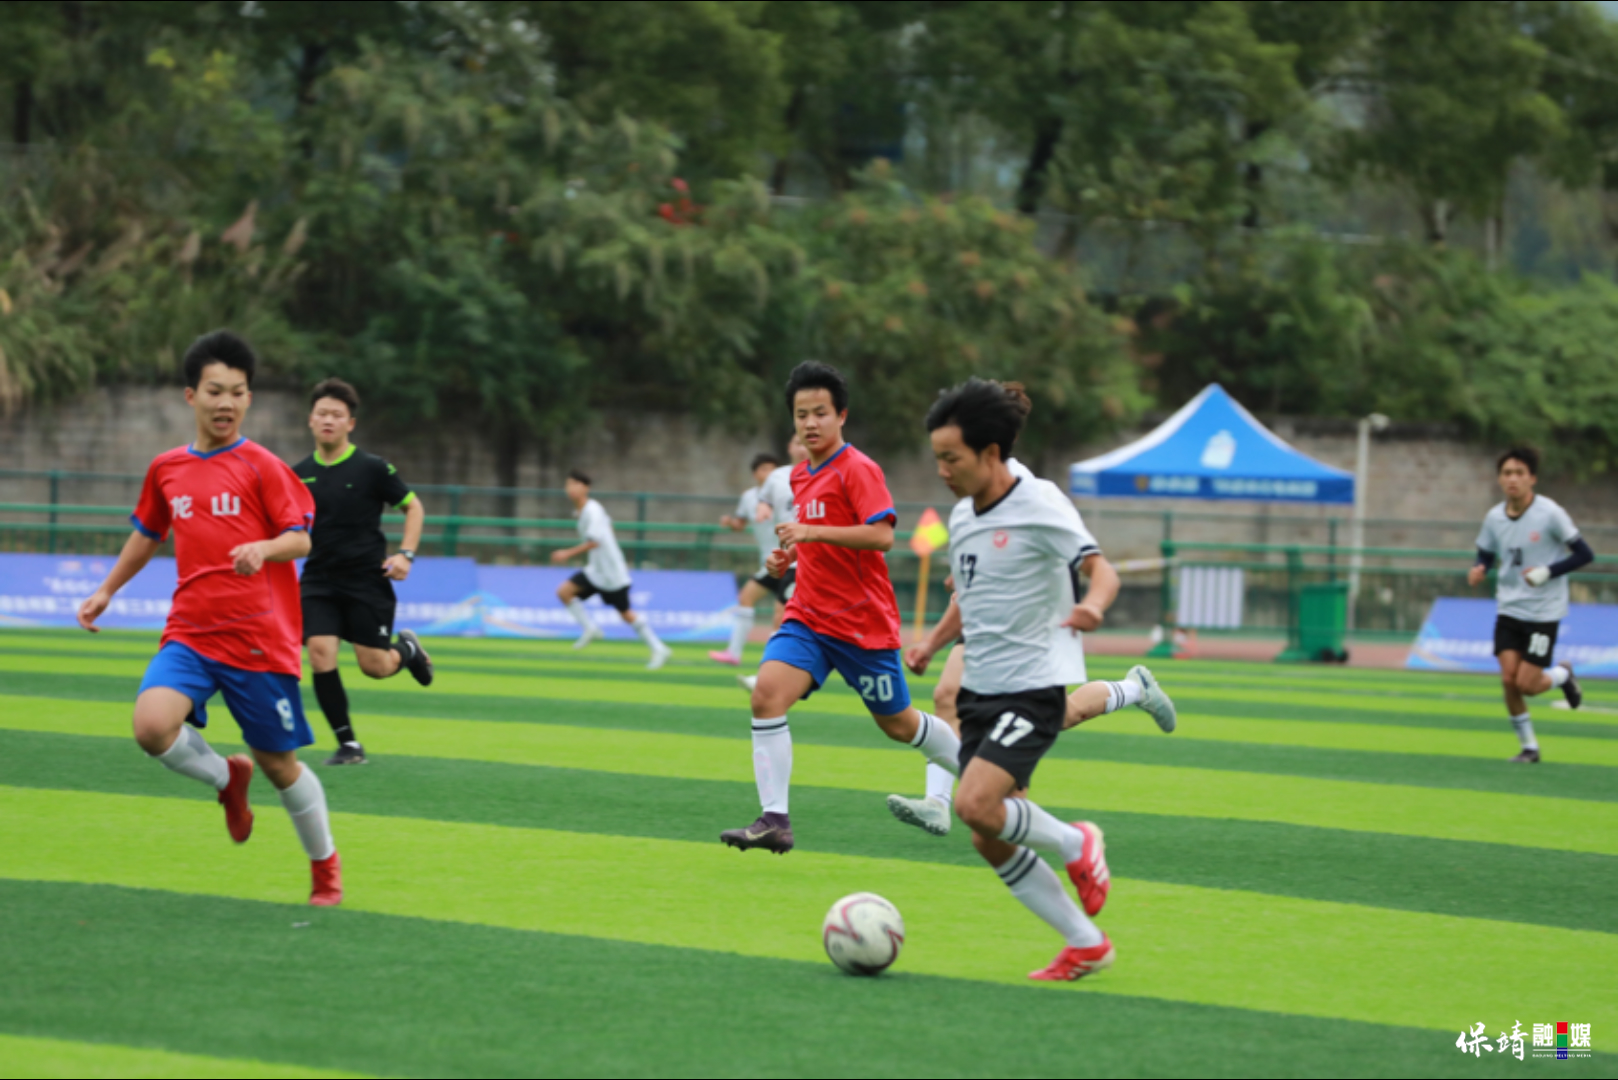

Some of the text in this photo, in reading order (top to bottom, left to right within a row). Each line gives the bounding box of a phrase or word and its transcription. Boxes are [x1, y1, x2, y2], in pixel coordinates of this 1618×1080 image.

[959, 553, 977, 588] 17
[1528, 632, 1549, 657] 10
[859, 674, 893, 702] 20
[990, 711, 1034, 747] 17
